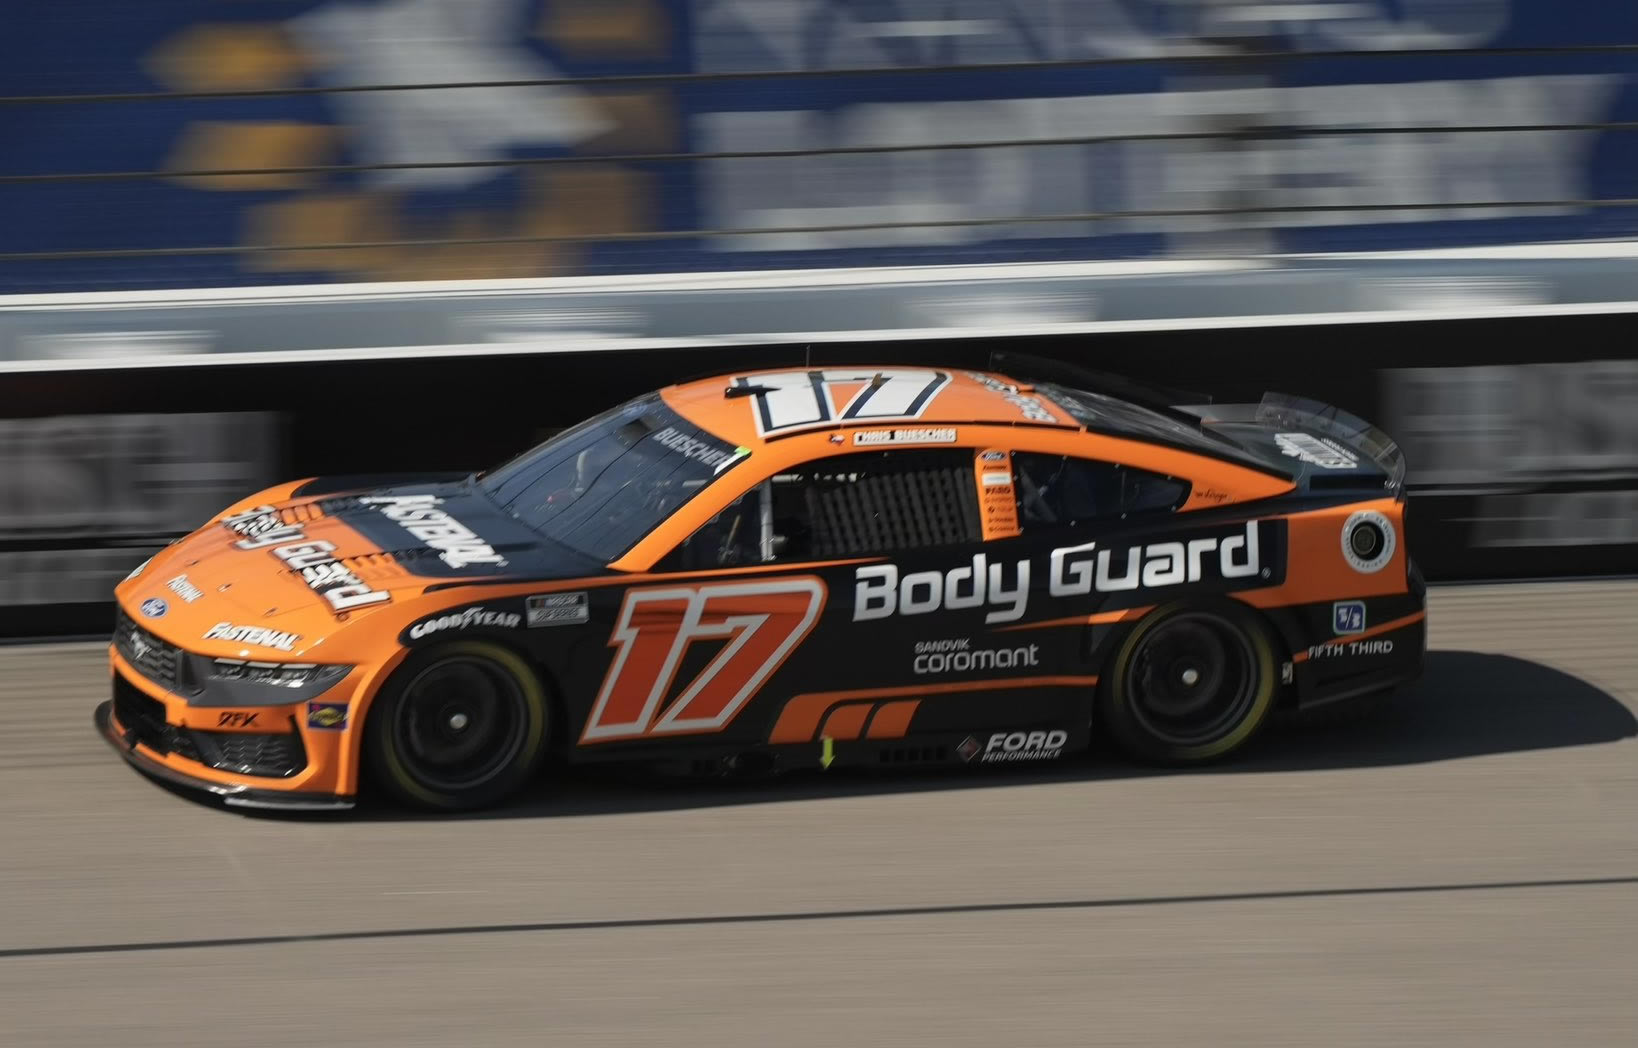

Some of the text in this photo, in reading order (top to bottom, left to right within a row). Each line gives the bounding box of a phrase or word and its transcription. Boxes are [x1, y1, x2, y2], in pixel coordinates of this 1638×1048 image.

[729, 370, 952, 438] 17
[852, 552, 1031, 625] Body
[1048, 519, 1260, 597] Guard
[201, 621, 301, 652] FASTENAL
[409, 606, 522, 640] GOODYEAR
[577, 575, 828, 745] 17
[913, 643, 1040, 675] coromant
[914, 638, 970, 654] SANDVIK
[1308, 640, 1393, 660] FIFTH THIRD
[981, 748, 1062, 762] PERFORMANCE
[984, 729, 1068, 753] FORD
